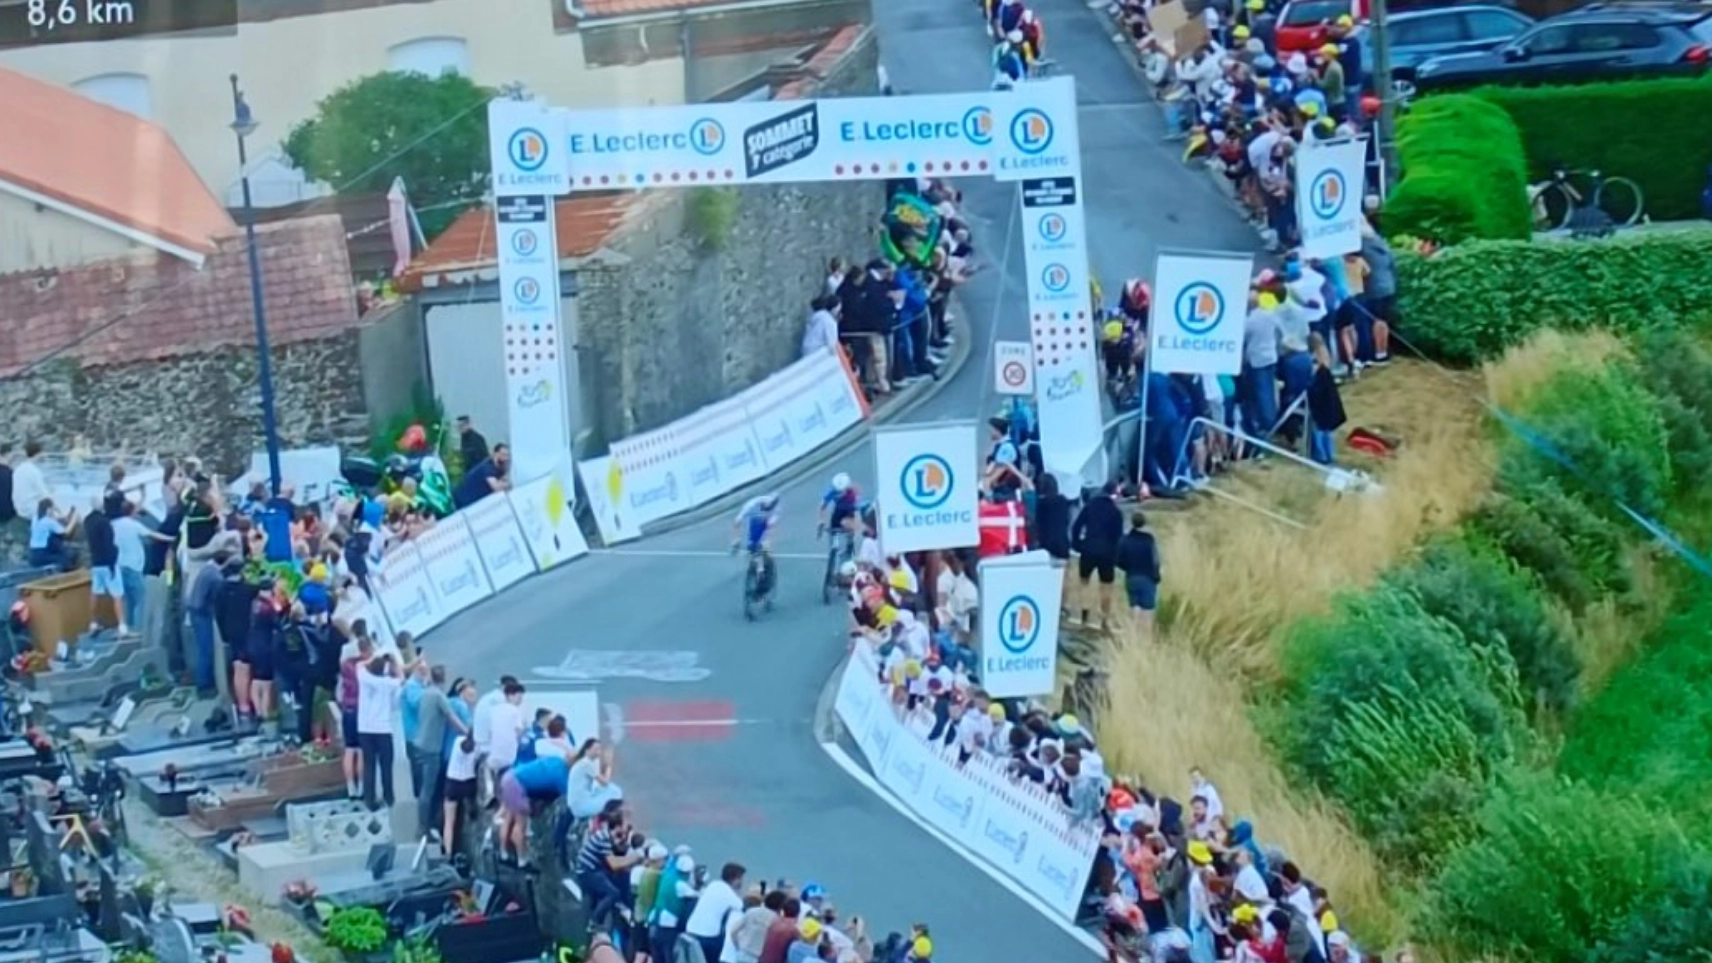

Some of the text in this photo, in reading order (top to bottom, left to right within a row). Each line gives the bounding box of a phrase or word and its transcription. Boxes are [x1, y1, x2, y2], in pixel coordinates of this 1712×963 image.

[840, 118, 960, 142] E.Leclerc
[571, 131, 686, 154] E.Leclerc
[887, 510, 971, 529] E.Leclerc
